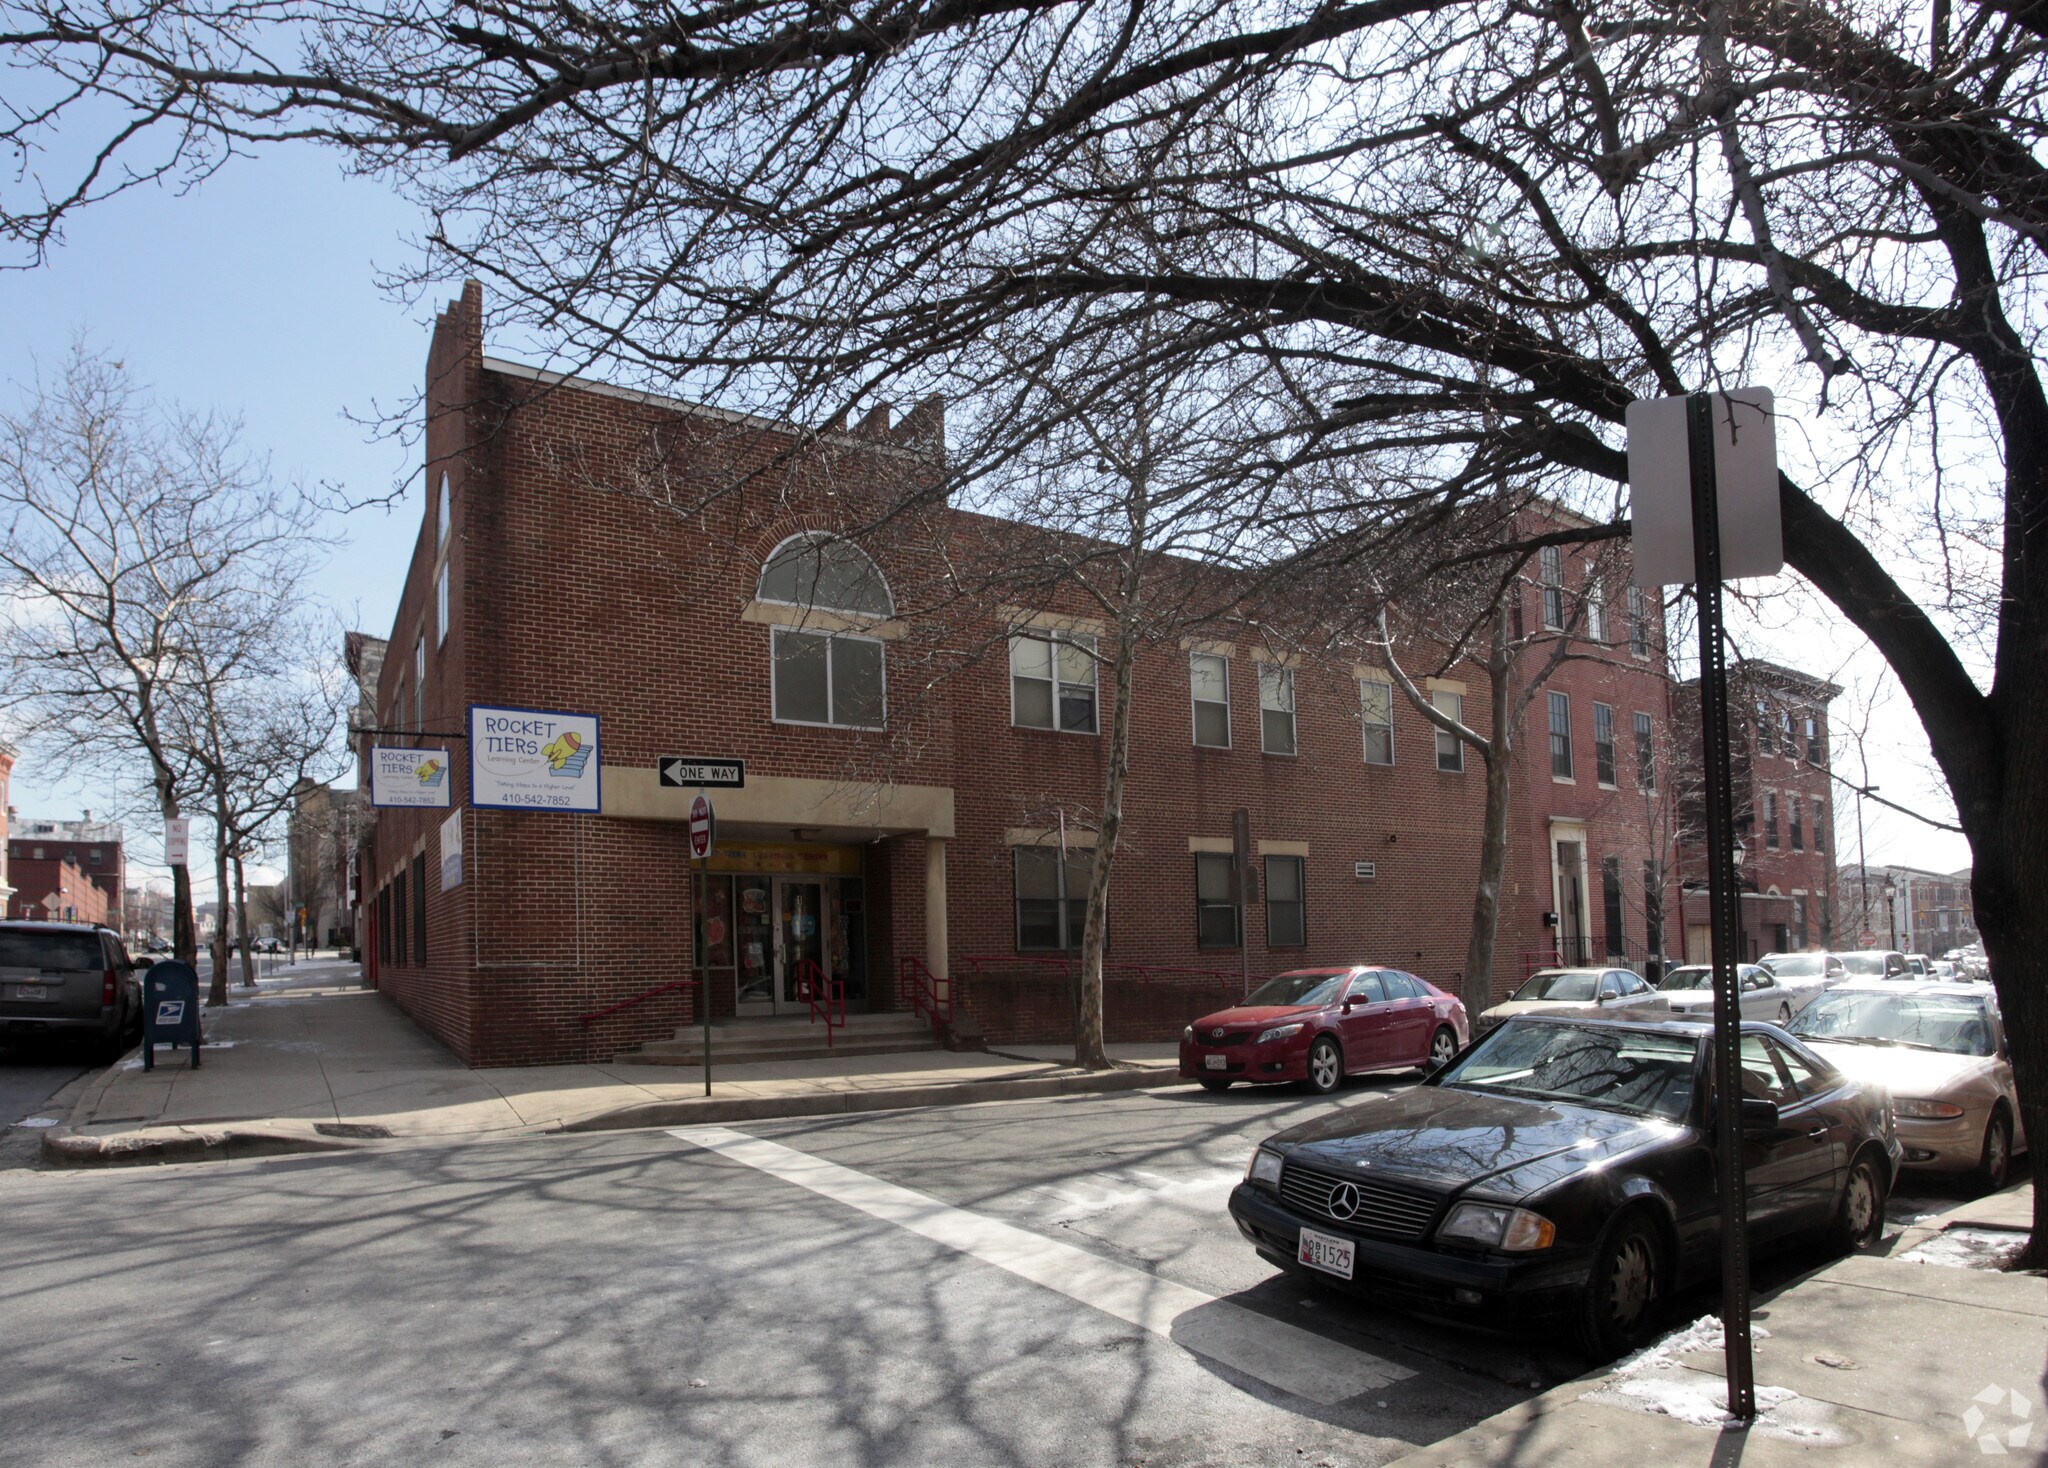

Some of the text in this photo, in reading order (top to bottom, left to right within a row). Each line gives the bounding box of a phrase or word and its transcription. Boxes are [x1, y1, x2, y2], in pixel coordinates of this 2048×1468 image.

[485, 717, 557, 738] ROCKET
[485, 737, 538, 755] TIERS
[380, 752, 424, 764] ROCKET
[487, 755, 541, 765] Learning Center
[380, 763, 413, 774] TIERS
[679, 767, 737, 780] ONE WAY
[388, 796, 436, 804] 410-542-7852
[502, 793, 571, 806] 410-542-7852
[698, 806, 707, 817] NOT
[172, 824, 182, 833] NO
[694, 834, 706, 845] ENTER
[1314, 1234, 1340, 1245] MARYLAND
